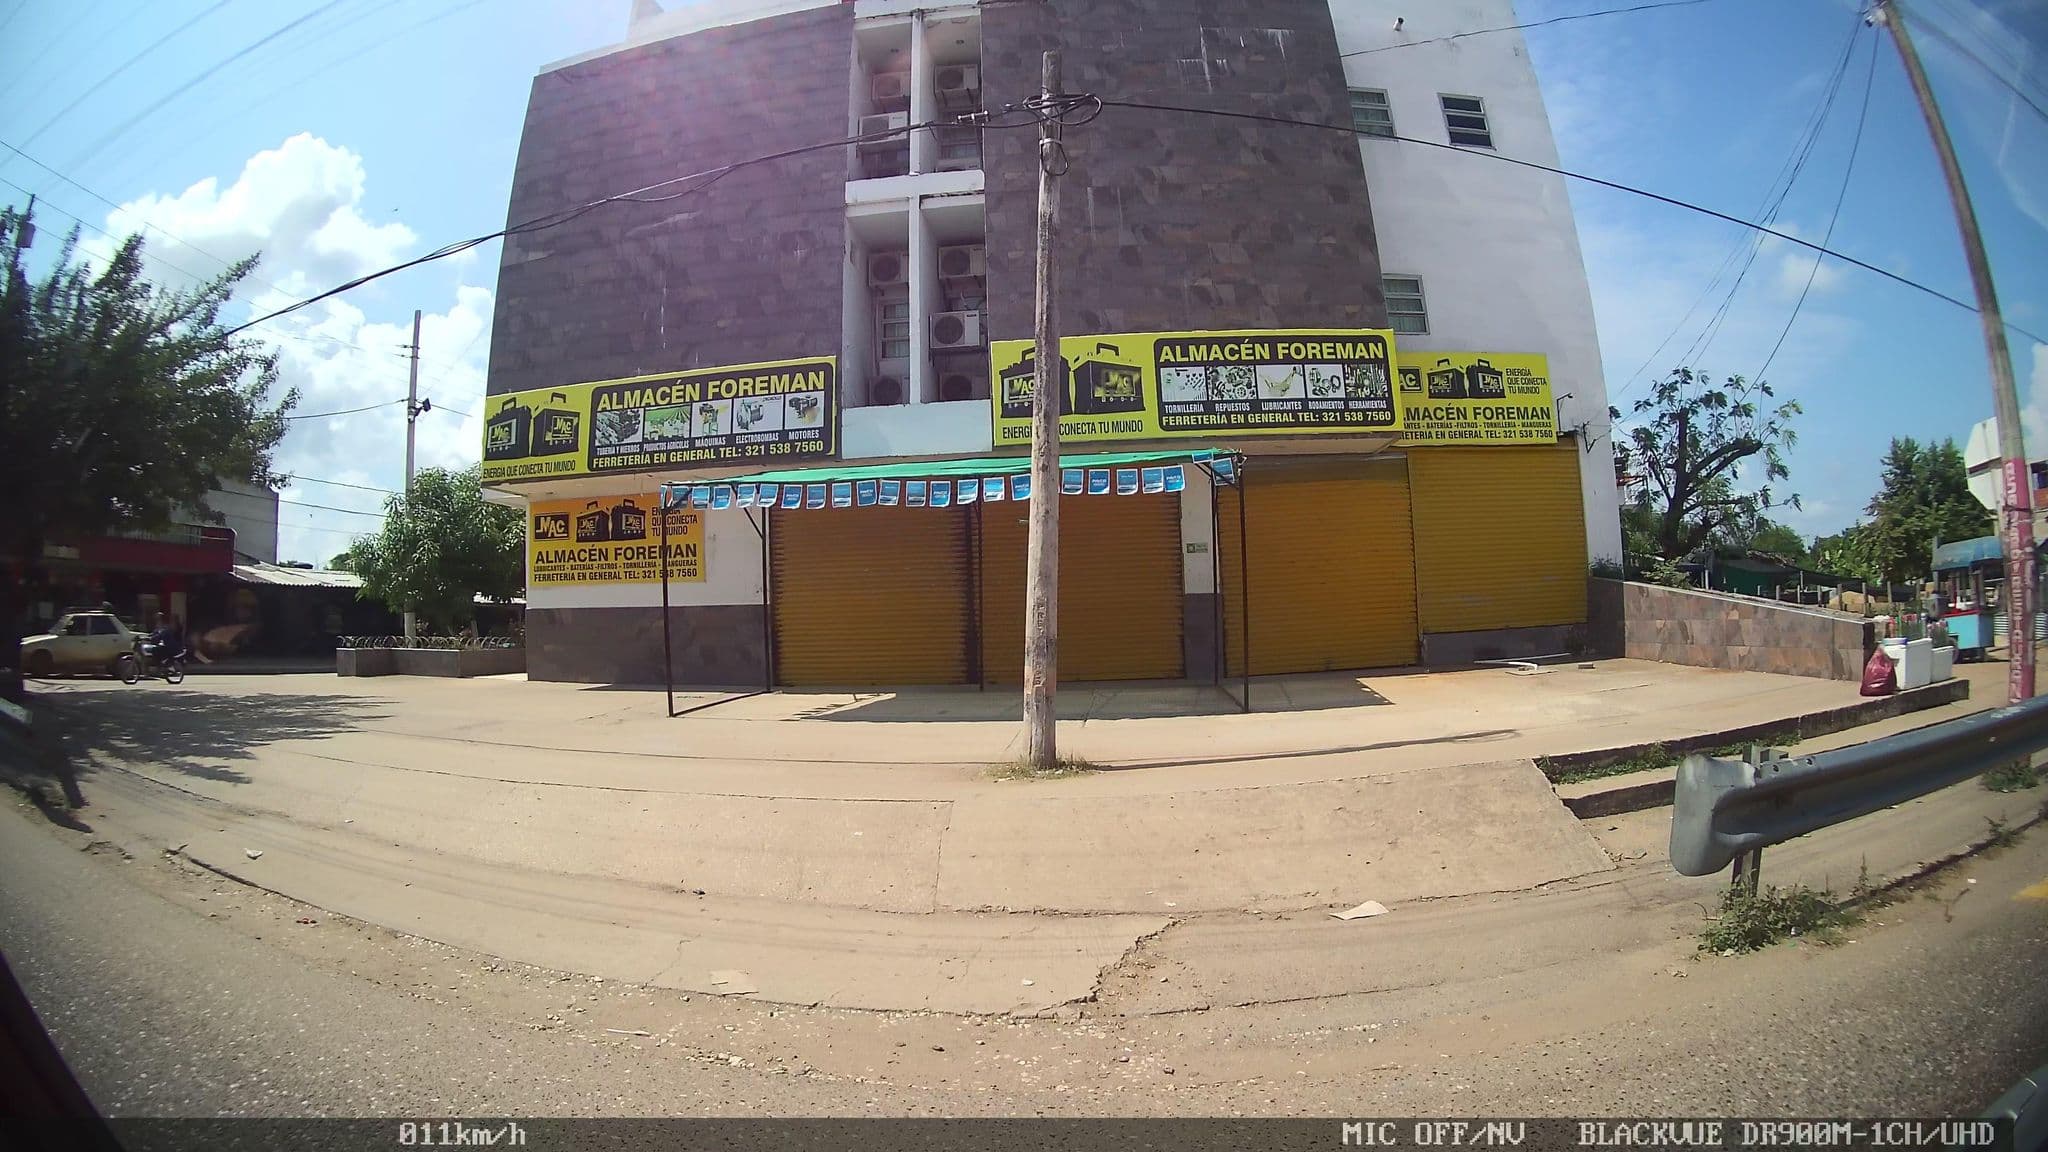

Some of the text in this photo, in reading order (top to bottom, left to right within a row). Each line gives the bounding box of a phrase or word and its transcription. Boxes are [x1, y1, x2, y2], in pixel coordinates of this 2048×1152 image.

[1160, 339, 1384, 362] ALMACÉN FOREMAN
[598, 371, 825, 411] ALMACÉN FOREMAN
[1508, 386, 1540, 394] TU MUNDO
[1215, 402, 1250, 412] REPUESTOS
[1261, 401, 1302, 410] LUBRICANTES
[1308, 400, 1345, 409] RODAMIENTOS
[1349, 400, 1387, 409] HERRAMIENTAS
[1163, 411, 1391, 426] FERRETERÍA EN GENERAL TEL: 321 538 7560
[1473, 407, 1550, 420] FOREMAN
[1059, 422, 1096, 436] CONECTA
[1098, 421, 1110, 434] TU
[1111, 420, 1143, 433] MUNDO
[1436, 431, 1445, 439] EN
[1448, 430, 1483, 439] GENERAL
[1503, 430, 1517, 438] 321
[1519, 429, 1533, 438] 538
[1535, 429, 1553, 437] 7560
[789, 430, 820, 440] MOTORES
[654, 453, 667, 463] EN
[670, 449, 716, 462] GENERAL
[719, 447, 742, 458] TEL:
[745, 445, 765, 456] 321
[769, 443, 791, 454] 538
[794, 441, 824, 452] 7560
[545, 461, 553, 472] TU
[553, 460, 576, 472] MUNDO
[536, 517, 568, 537] MAC
[652, 527, 660, 536] TU
[536, 544, 608, 564] ALMACÉN
[578, 572, 587, 580] EN
[589, 571, 622, 580] GENERAL
[642, 569, 656, 578] 321
[677, 568, 697, 577] 7560
